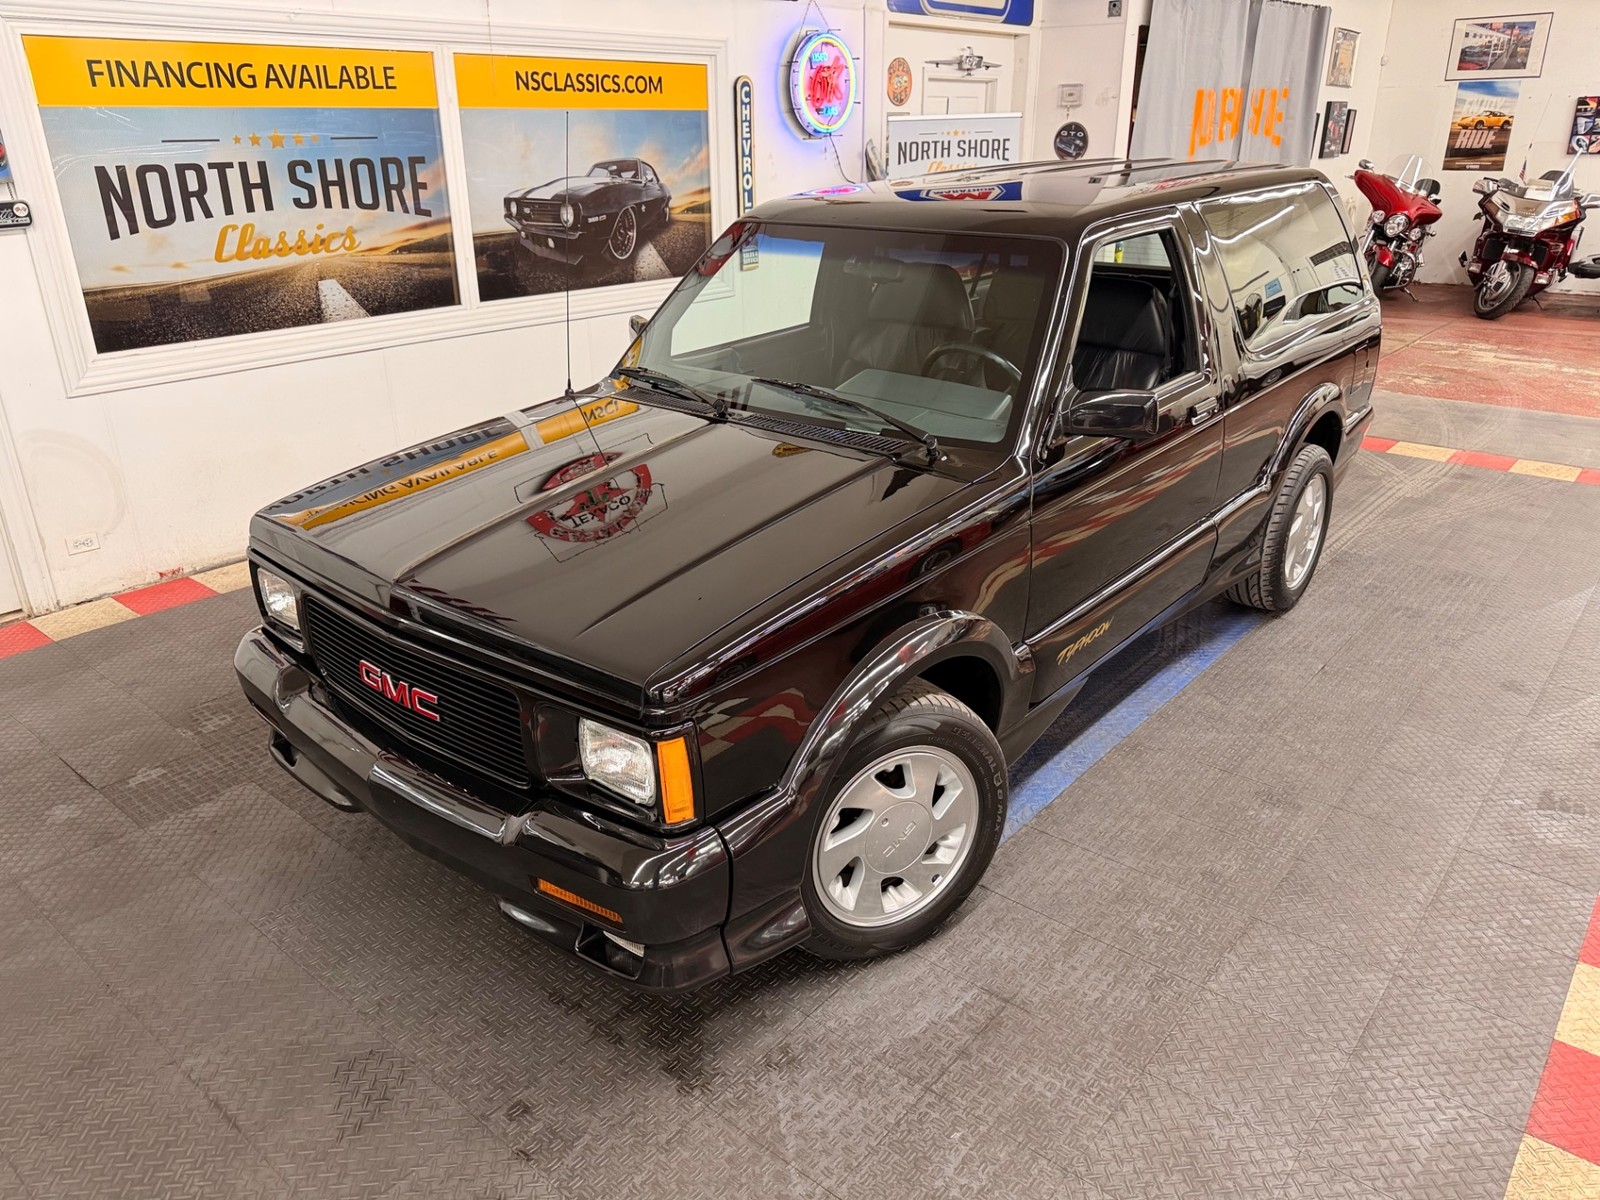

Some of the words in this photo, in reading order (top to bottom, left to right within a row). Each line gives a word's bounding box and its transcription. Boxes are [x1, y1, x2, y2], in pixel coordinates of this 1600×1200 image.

[86, 59, 257, 89] FINANCING
[264, 63, 398, 90] AVAILABLE
[515, 70, 663, 95] NSCLASSICS.COM
[741, 86, 753, 213] CHEVROL
[897, 140, 951, 166] NORTH
[956, 138, 1010, 162] SHORE
[1060, 130, 1085, 138] GTO
[1454, 129, 1499, 149] RIDE
[93, 160, 276, 241] NORTH
[287, 156, 433, 218] SHORE
[214, 222, 363, 264] Classics
[1056, 616, 1114, 665] TYPHOON
[359, 659, 440, 721] GMC
[882, 820, 917, 858] GMC
